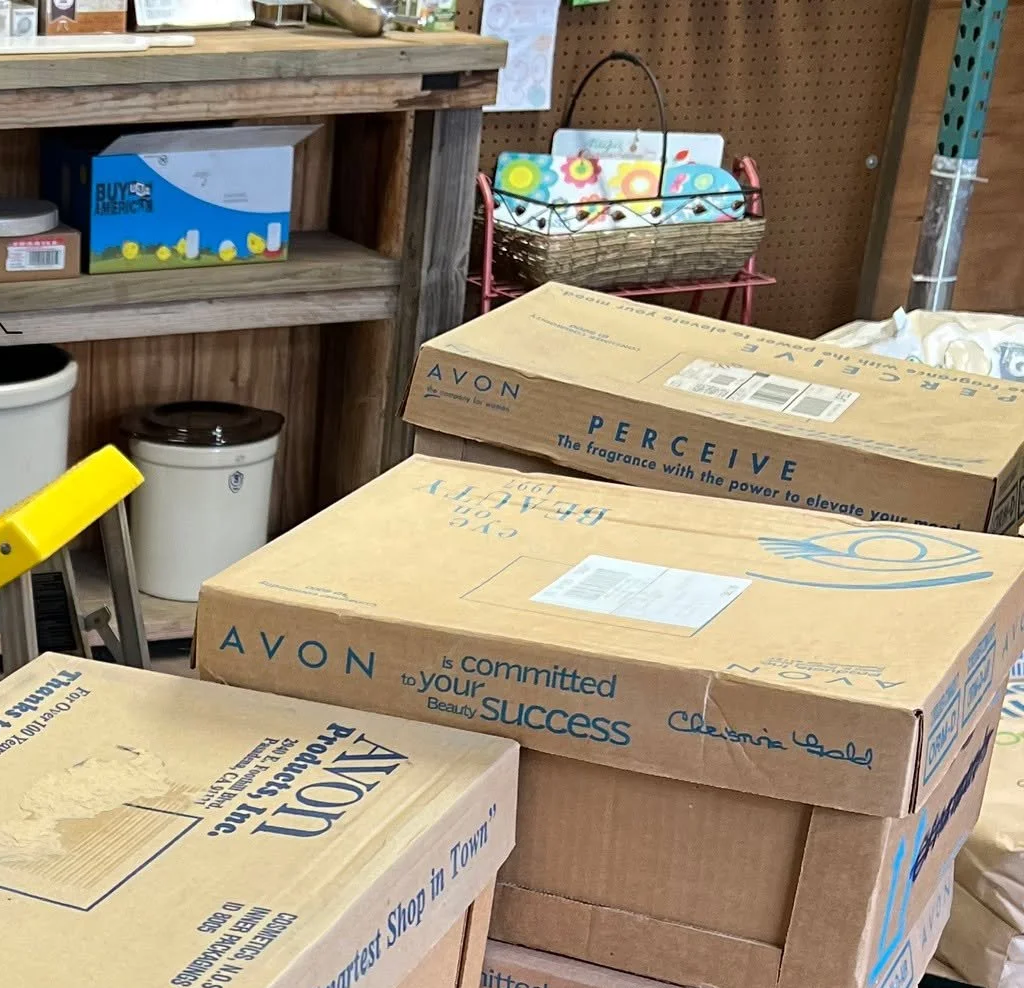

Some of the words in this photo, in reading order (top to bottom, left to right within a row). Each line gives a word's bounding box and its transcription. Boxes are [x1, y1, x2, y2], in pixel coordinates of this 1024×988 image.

[96, 183, 126, 200] BUY
[427, 363, 520, 400] AVON
[741, 343, 1017, 402] PERCEIVE
[587, 414, 797, 482] PERCEIVE
[557, 433, 581, 452] The
[585, 439, 657, 471] fragrance
[662, 461, 695, 481] with
[700, 470, 725, 488] the
[728, 478, 779, 502] power
[785, 488, 801, 504] to
[806, 493, 864, 518] elevate
[412, 479, 613, 526] BEAUTY
[219, 625, 375, 679] AVON
[401, 672, 416, 687] to
[417, 670, 485, 699] your
[442, 655, 453, 670] is
[461, 656, 617, 699] committed
[726, 662, 906, 690] AVON
[4, 670, 83, 719] Thanks
[39, 702, 72, 722] Over
[65, 686, 92, 704] For
[426, 697, 476, 720] Beauty
[20, 720, 47, 737] 100
[246, 723, 357, 799] Products,
[215, 773, 239, 785] CA
[207, 803, 268, 837] Inc.
[196, 912, 232, 934] 8005
[221, 901, 246, 912] ID
[229, 906, 273, 933] INNER
[386, 887, 427, 950] Shop
[429, 867, 445, 901] in
[227, 912, 299, 961] COSMETICS,
[170, 933, 243, 988] PACKAGINGS
